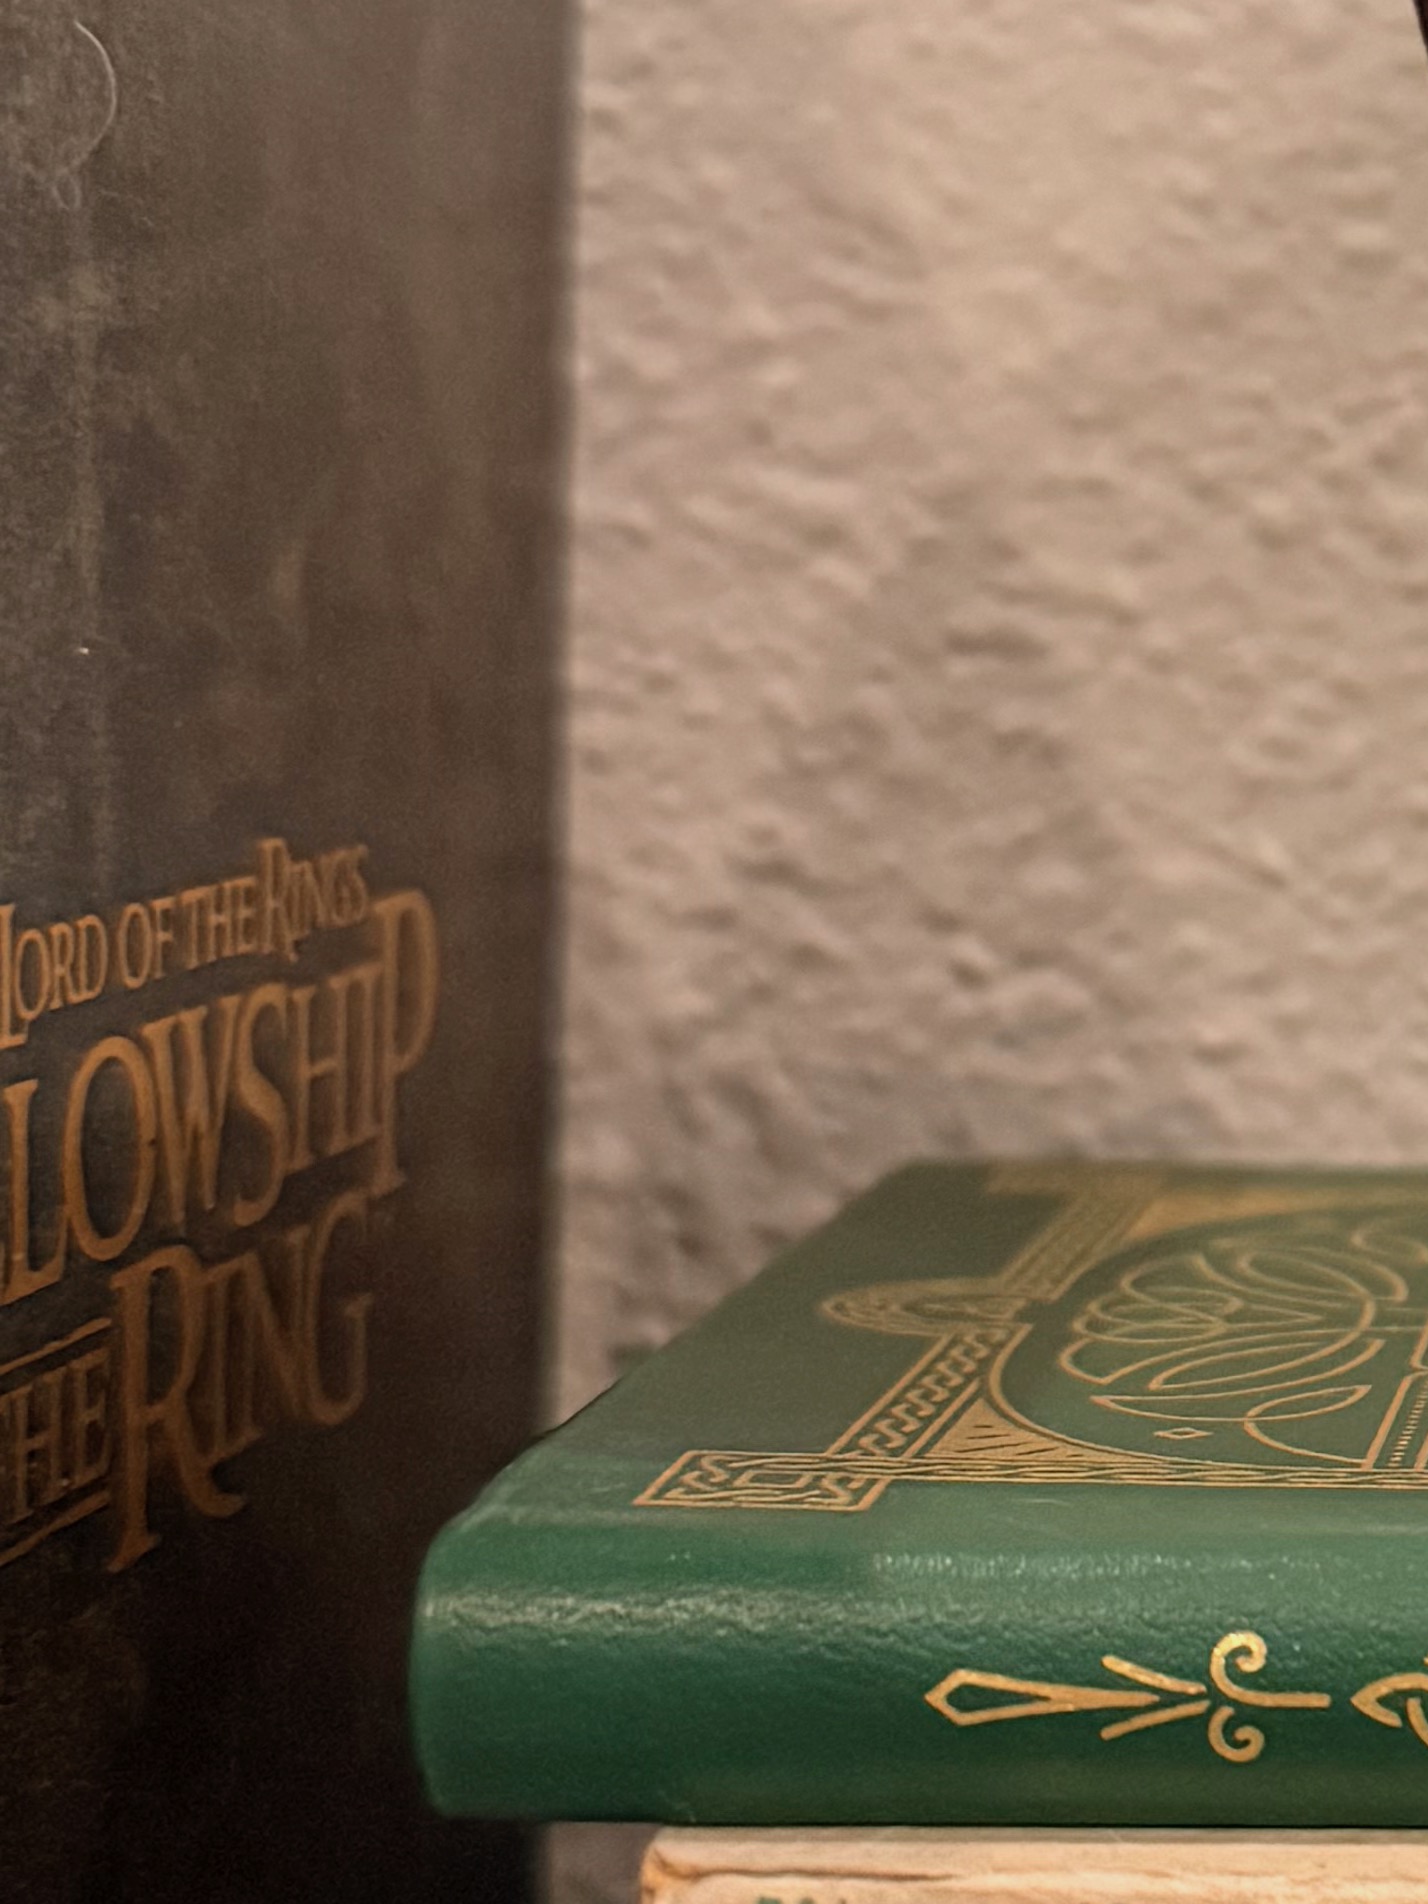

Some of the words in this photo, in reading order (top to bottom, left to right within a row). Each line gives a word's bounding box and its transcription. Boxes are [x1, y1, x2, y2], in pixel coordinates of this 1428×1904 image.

[0, 889, 442, 1300] LOWSHIP
[116, 900, 174, 992] OF
[178, 875, 257, 971] THE
[256, 836, 370, 963] RINGS
[107, 1194, 373, 1573] RING
